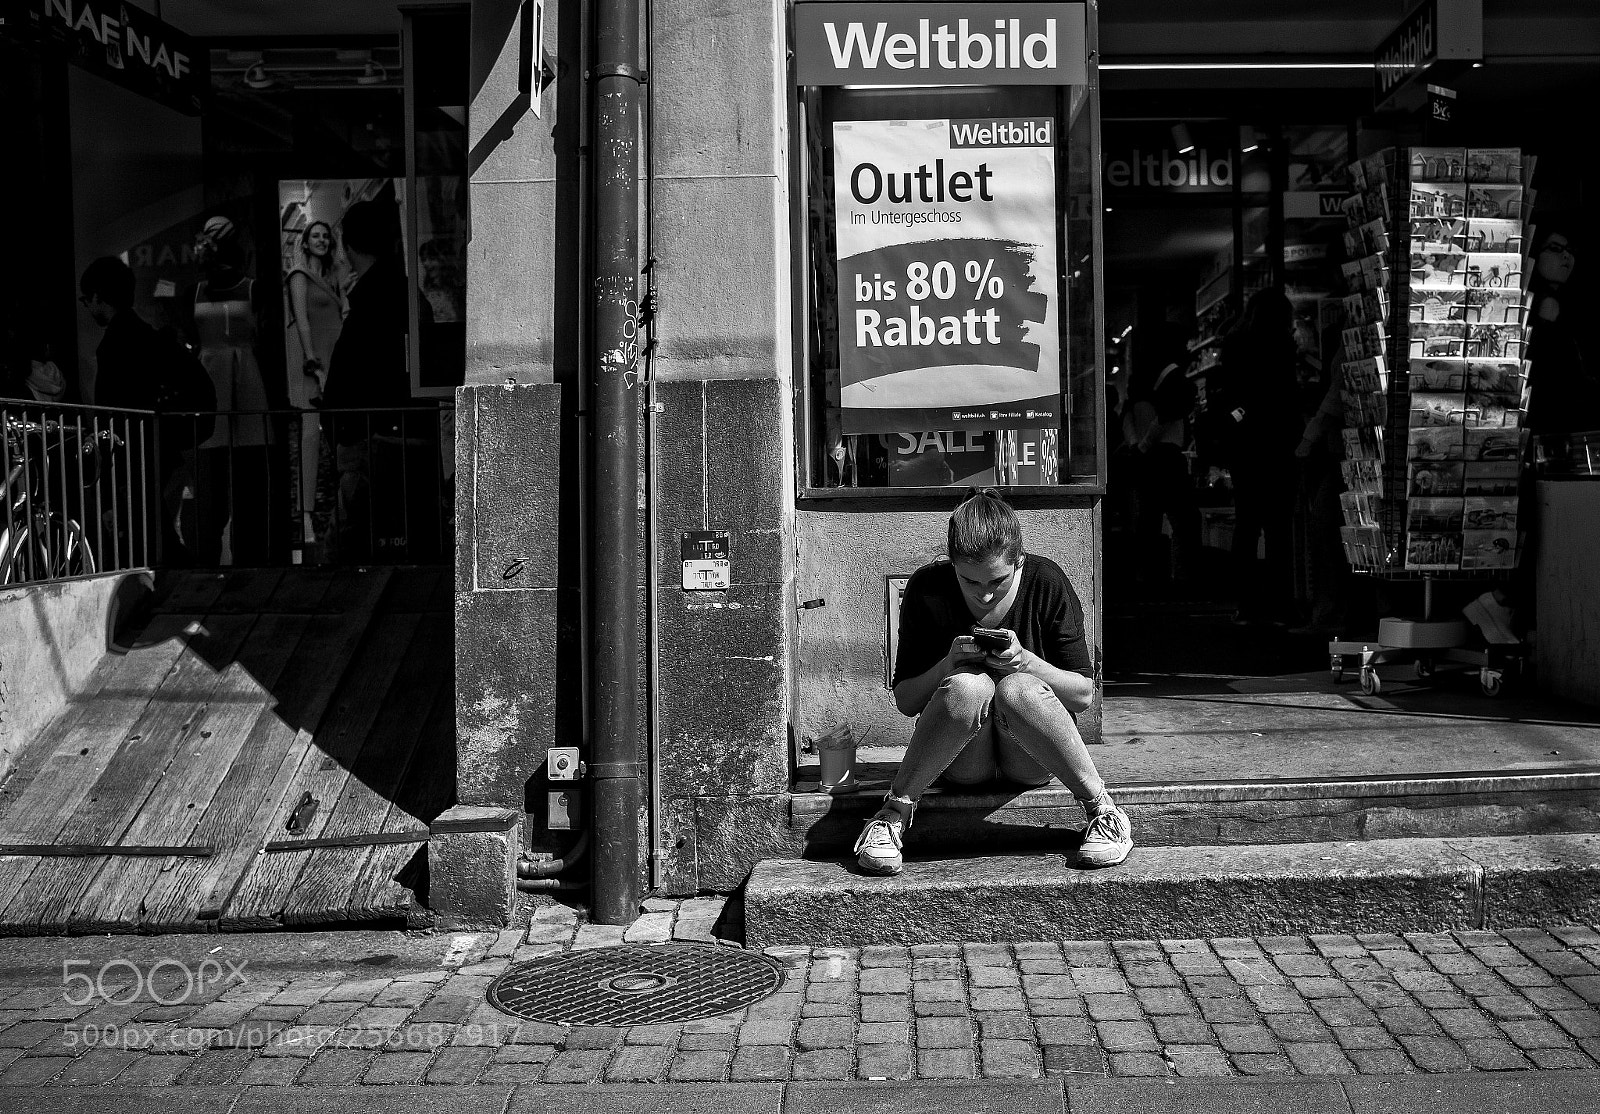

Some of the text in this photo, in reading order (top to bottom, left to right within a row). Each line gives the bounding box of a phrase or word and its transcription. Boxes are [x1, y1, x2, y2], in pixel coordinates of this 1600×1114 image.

[45, 0, 190, 80] NAF NAF
[823, 18, 1057, 70] Weltbild
[1380, 6, 1432, 93] Weltbild
[952, 121, 1050, 146] Weltbild
[850, 158, 994, 204] Outlet
[1102, 148, 1233, 187] eltbild
[850, 208, 962, 228] Im Untergeschoss
[855, 258, 1004, 301] bis 80 %
[855, 305, 1001, 348] Rabatt
[897, 430, 985, 454] SALE
